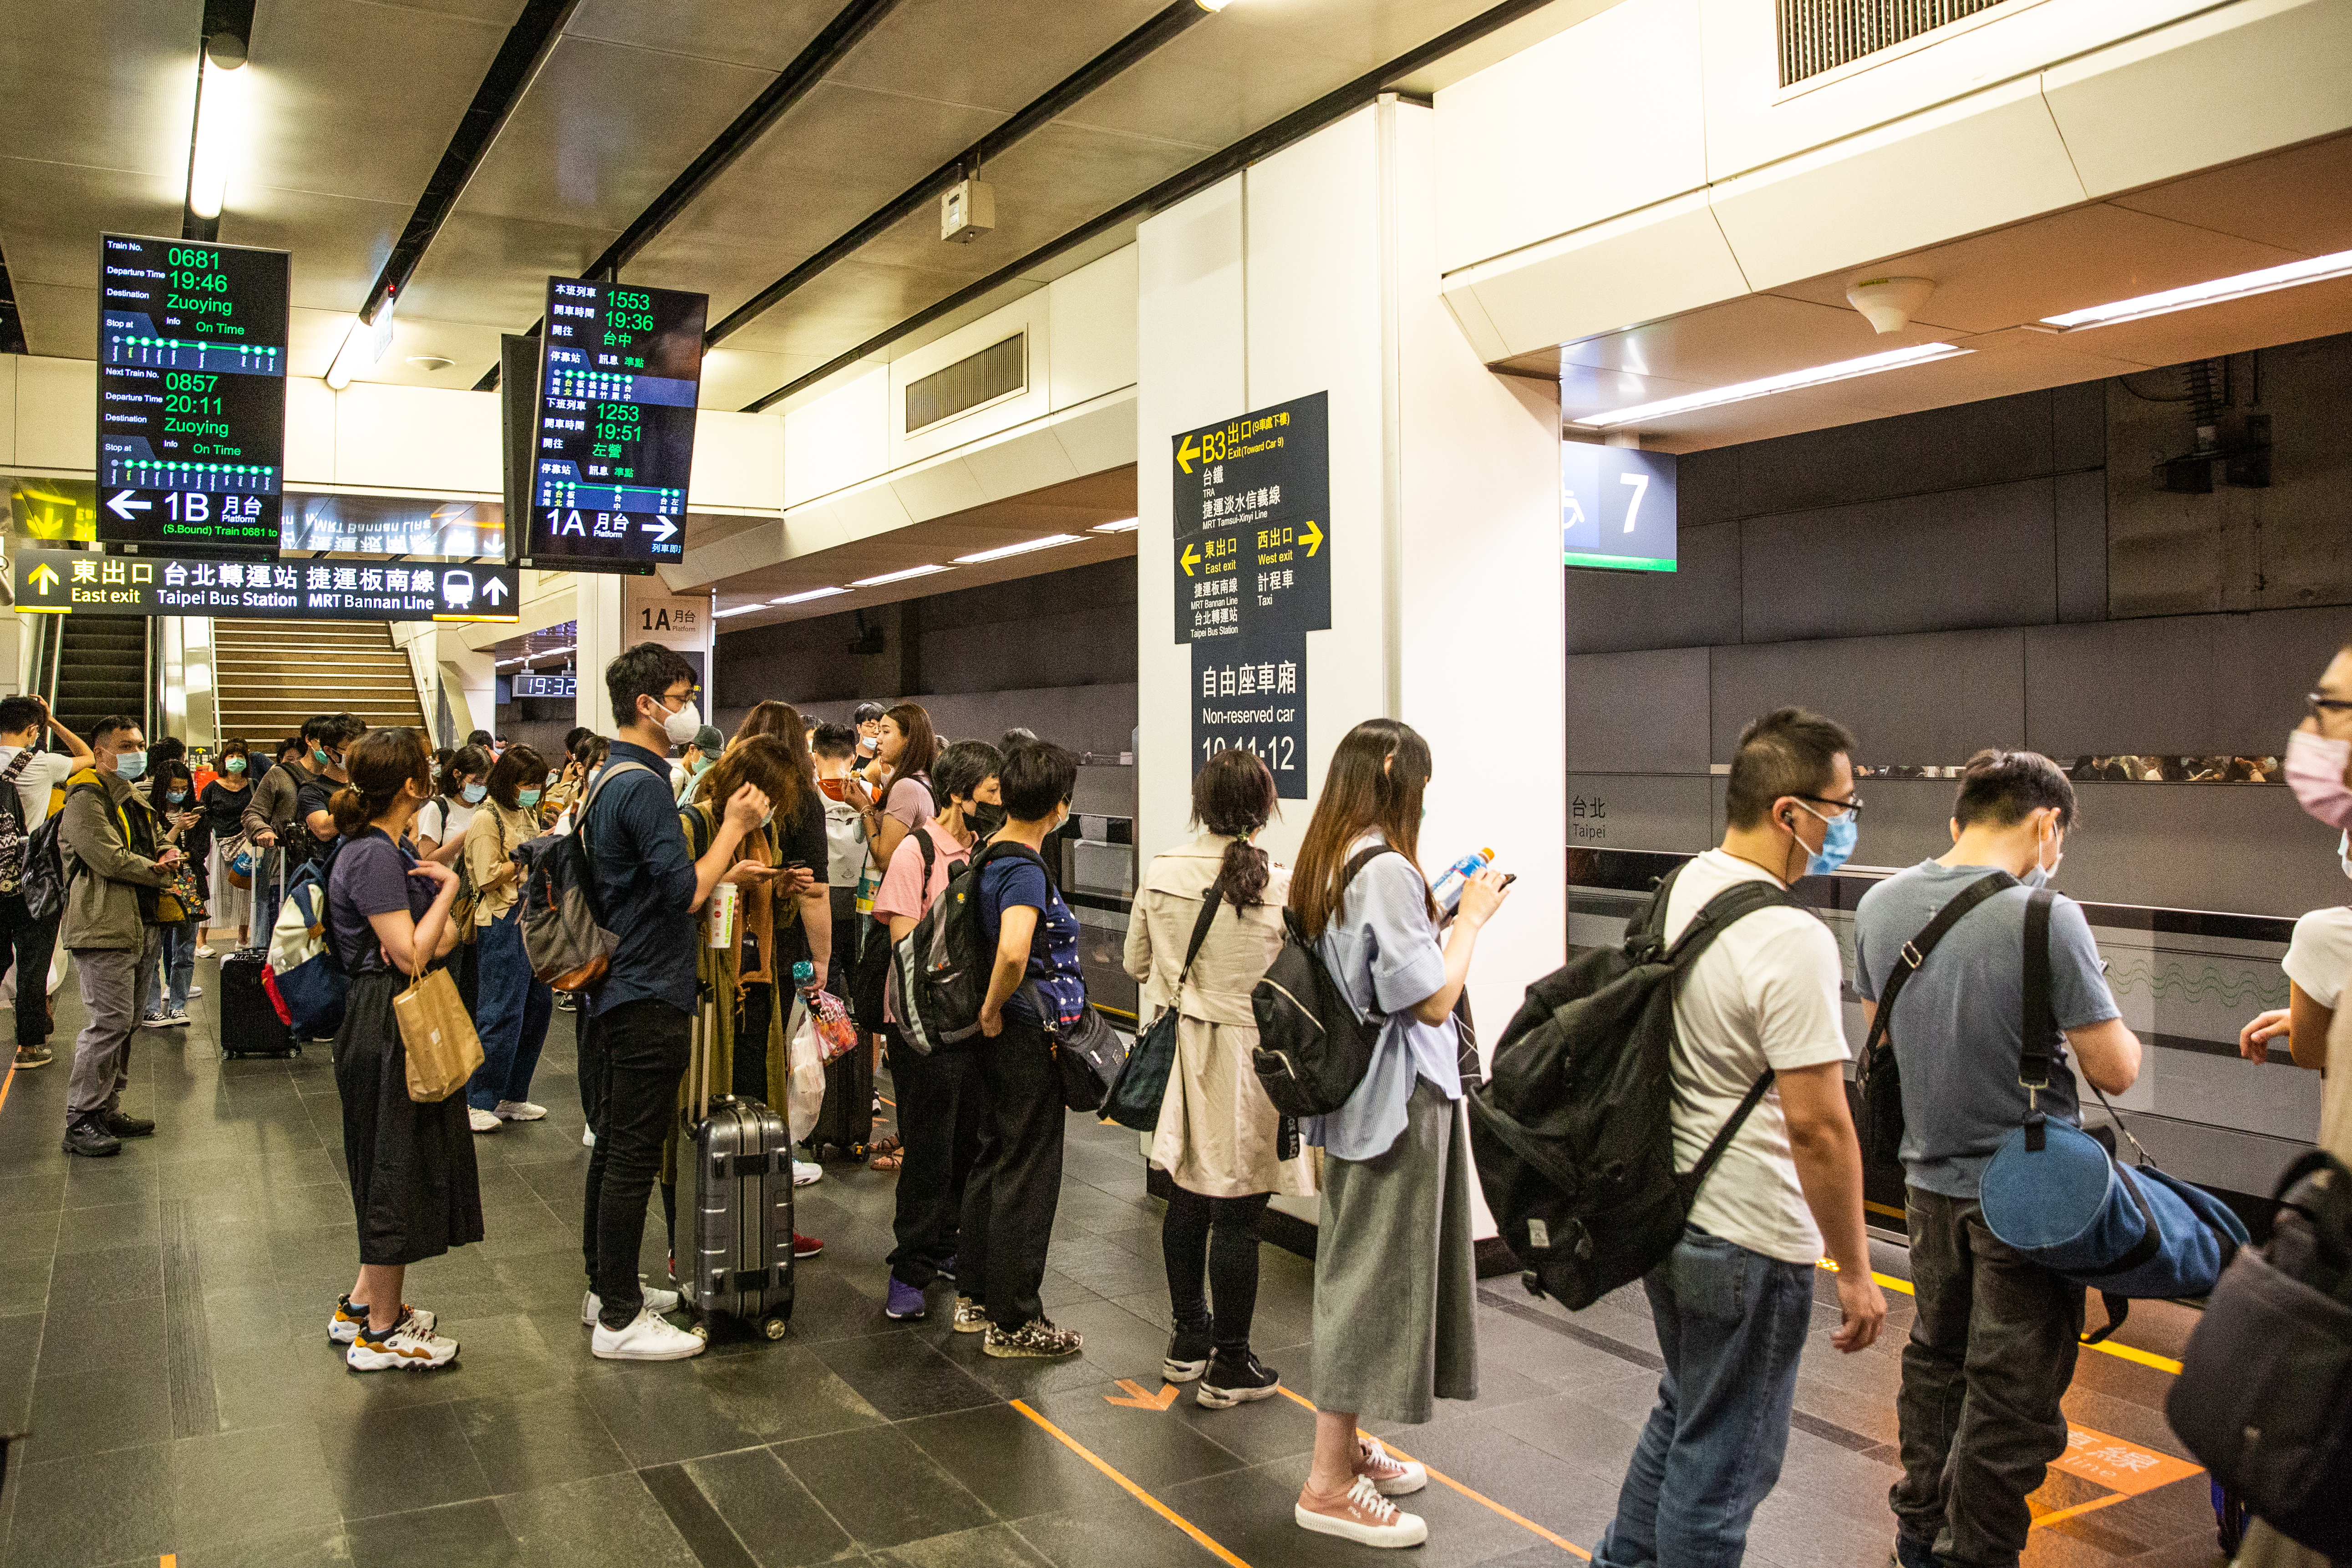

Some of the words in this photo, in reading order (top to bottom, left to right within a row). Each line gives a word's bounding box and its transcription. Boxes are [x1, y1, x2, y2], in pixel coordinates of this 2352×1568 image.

[107, 241, 127, 250] Train
[129, 243, 142, 252] No.
[168, 248, 219, 269] 0681
[107, 266, 145, 277] Departure
[147, 269, 166, 279] Time
[169, 270, 227, 292] 19:46
[107, 288, 149, 299] Destination
[555, 284, 596, 298] 本班列車
[167, 294, 232, 315] Zuoying
[608, 290, 650, 310] 1553
[554, 304, 595, 318] 開車時間
[106, 319, 124, 328] Stop
[166, 317, 181, 325] Info
[196, 321, 213, 332] On
[216, 323, 244, 335] Time
[605, 311, 653, 331] 19:36
[552, 325, 573, 336] 開往
[604, 330, 632, 347] 台中
[550, 351, 581, 364] 停靠站
[598, 354, 619, 365] 訊息
[625, 356, 644, 368] 準點
[106, 367, 124, 376] Next
[126, 369, 144, 377] Train
[146, 370, 159, 379] No.
[165, 372, 218, 392] 0857
[552, 378, 560, 395] 南港
[564, 380, 572, 396] 台北
[576, 380, 585, 397] 板橋
[106, 392, 142, 402] Departure
[600, 382, 609, 399] 新竹
[611, 383, 620, 400] 苗栗
[624, 385, 632, 401] 台中
[165, 395, 221, 415] 20:11
[547, 398, 586, 411] 下班列車
[597, 403, 639, 421] 1253
[106, 414, 147, 423] Destination
[544, 418, 585, 431] 開車時間
[164, 417, 229, 437] Zuoying
[595, 423, 641, 441] 19:51
[105, 443, 122, 452] Stop
[193, 443, 210, 454] On
[213, 445, 241, 456] Time
[543, 438, 564, 449] 開往
[593, 443, 622, 458] 左營
[1203, 431, 1226, 464] B3
[1228, 421, 1251, 445] 出口
[1228, 448, 1241, 459] Exit
[1242, 442, 1264, 458] (Toward
[1266, 440, 1276, 450] Car
[1277, 436, 1284, 448] 9)
[541, 463, 571, 475] 停靠站
[589, 465, 609, 476] 訊息
[614, 467, 634, 478] 準點
[1203, 465, 1224, 487] 台鐵
[543, 489, 551, 506] 南港
[554, 491, 564, 507] 台北
[567, 491, 575, 507] 板橋
[1203, 488, 1215, 498] TRA
[165, 492, 209, 522] 1B
[222, 496, 262, 515] 月台
[614, 494, 622, 510] 台中
[659, 497, 668, 513] 台南
[671, 498, 679, 514] 左營
[1203, 485, 1280, 519] 捷運淡水信義線
[1620, 472, 1649, 533] 7
[222, 514, 255, 523] Platform
[547, 509, 586, 537] 1A
[594, 513, 629, 531] 月台
[1203, 519, 1215, 530] MRT
[1217, 511, 1253, 527] Tamsui-Xinyi
[1255, 510, 1267, 519] Line
[163, 524, 212, 535] (S.Bound)
[215, 526, 239, 536] Train
[242, 527, 265, 536] 0681
[269, 528, 278, 537] to
[593, 530, 622, 538] Platform
[1257, 527, 1292, 550] 西出口
[651, 543, 681, 553] 列車即
[1205, 538, 1236, 559] 東出口
[1258, 553, 1277, 565] West
[1279, 550, 1293, 561] exit
[71, 559, 152, 585] 東出口
[1205, 563, 1220, 574] East
[1224, 560, 1236, 570] exit
[164, 561, 298, 590] 台北轉運站
[306, 566, 435, 593] 捷運板南線
[1258, 569, 1294, 592] 計程車
[72, 588, 107, 603] East
[112, 589, 140, 604] exit
[1194, 578, 1238, 598] 捷運板南線
[157, 589, 205, 607] Taipei
[210, 591, 239, 605] Bus
[243, 591, 298, 607] Station
[309, 594, 341, 608] MRT
[345, 595, 400, 609] Bannan
[404, 596, 434, 610] Line
[1191, 600, 1204, 610] MRT
[1204, 598, 1225, 608] Bannan
[1227, 597, 1238, 605] Line
[1258, 594, 1272, 606] Taxi
[642, 608, 670, 630] 1A
[674, 610, 695, 623] 月台
[1195, 607, 1238, 626] 台北轉運站
[1191, 628, 1206, 639] Taipei
[1207, 628, 1218, 637] Bus
[1219, 625, 1238, 635] Station
[529, 678, 577, 695] 19:32
[1204, 660, 1296, 697] 自由座車廂
[1203, 705, 1273, 724] Non-reserved
[1277, 708, 1295, 722] car
[1573, 796, 1605, 818] 台北
[1573, 824, 1605, 841] Taipei
